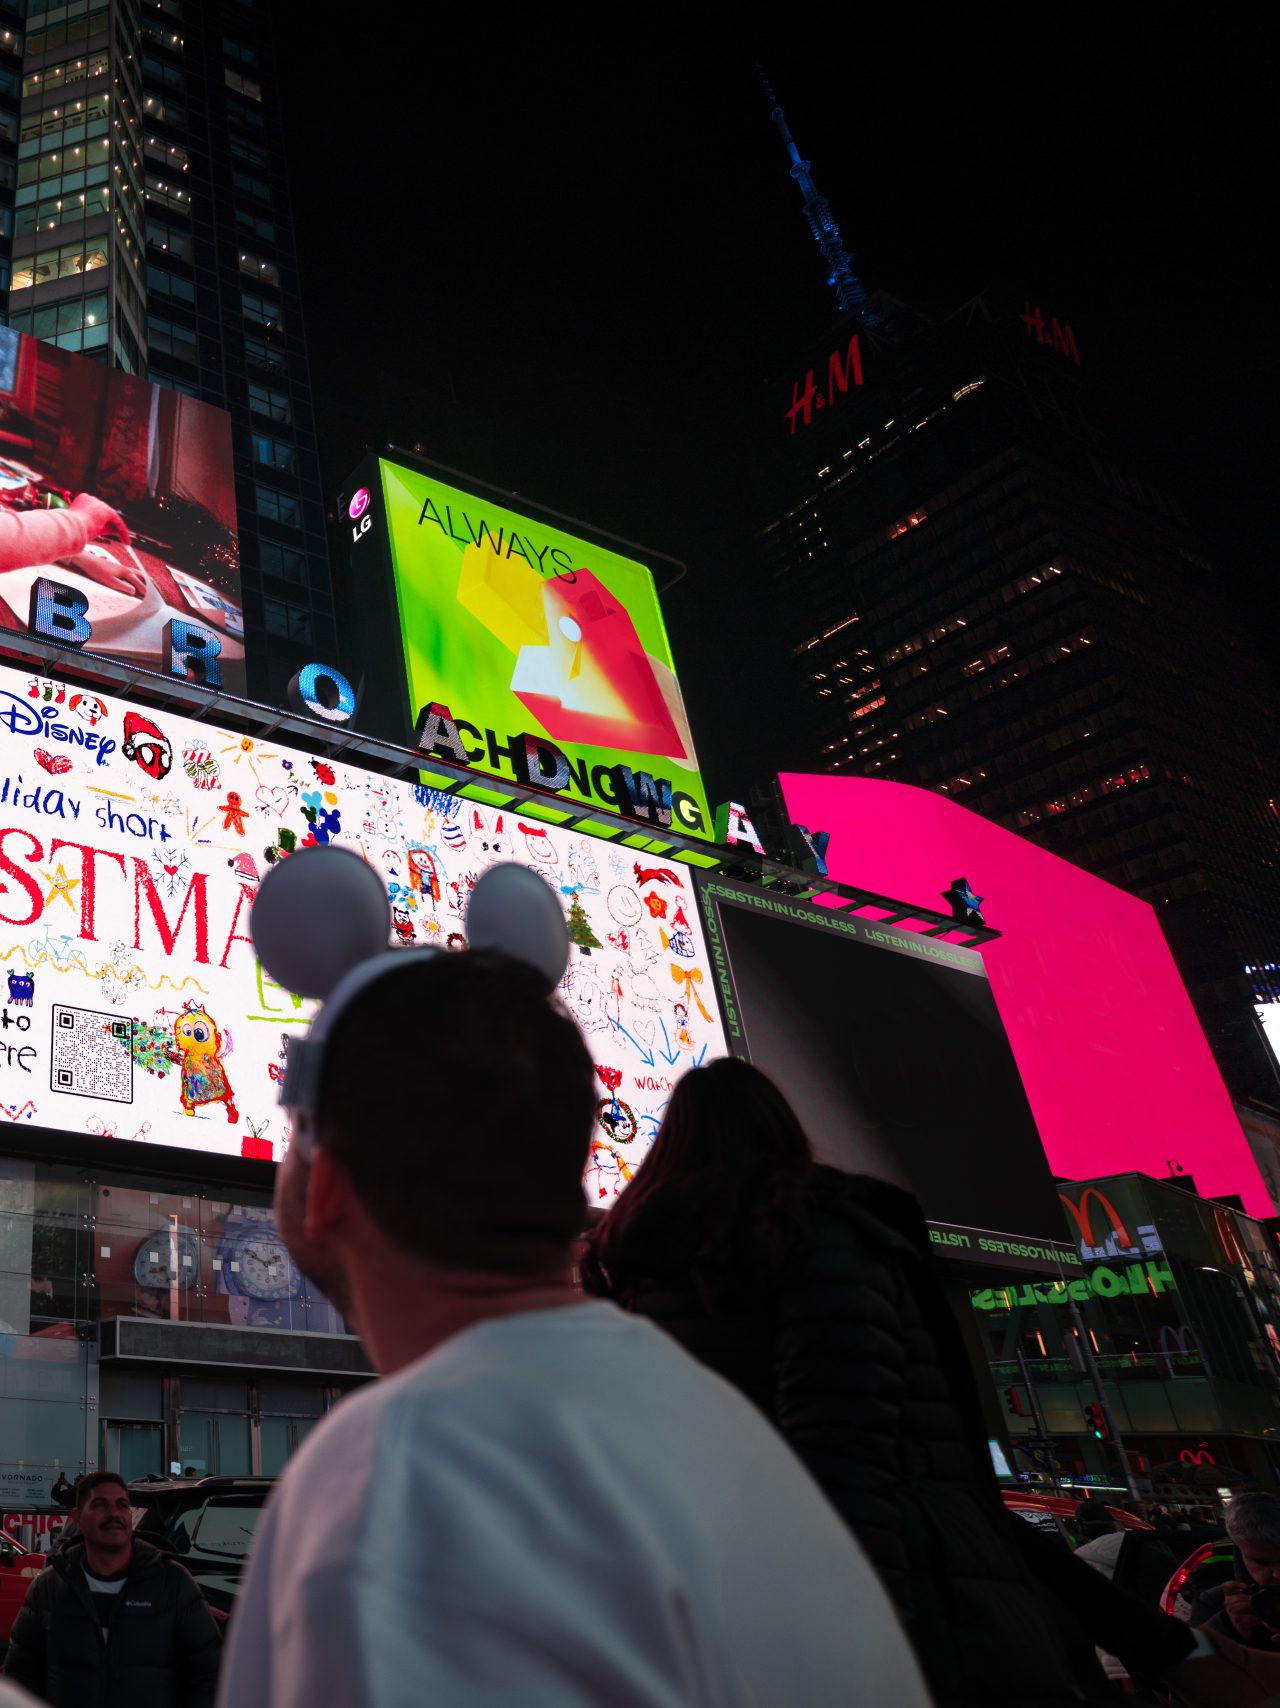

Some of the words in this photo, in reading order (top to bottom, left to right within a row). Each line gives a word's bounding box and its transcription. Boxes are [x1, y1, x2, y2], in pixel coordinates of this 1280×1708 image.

[1020, 301, 1083, 366] H&M
[784, 334, 864, 435] H&M
[352, 514, 372, 543] LG
[417, 495, 579, 585] ALWAYS
[95, 800, 172, 843] short
[773, 904, 789, 916] IN
[789, 905, 857, 935] LOSSLESS
[864, 928, 909, 951] LISTEN
[907, 940, 922, 954] IN
[713, 946, 725, 969] IN
[720, 969, 741, 1038] LISTEN
[1, 1008, 31, 1032] to
[978, 1237, 1046, 1260] LOSSLESS
[1, 1474, 43, 1482] VORNADO
